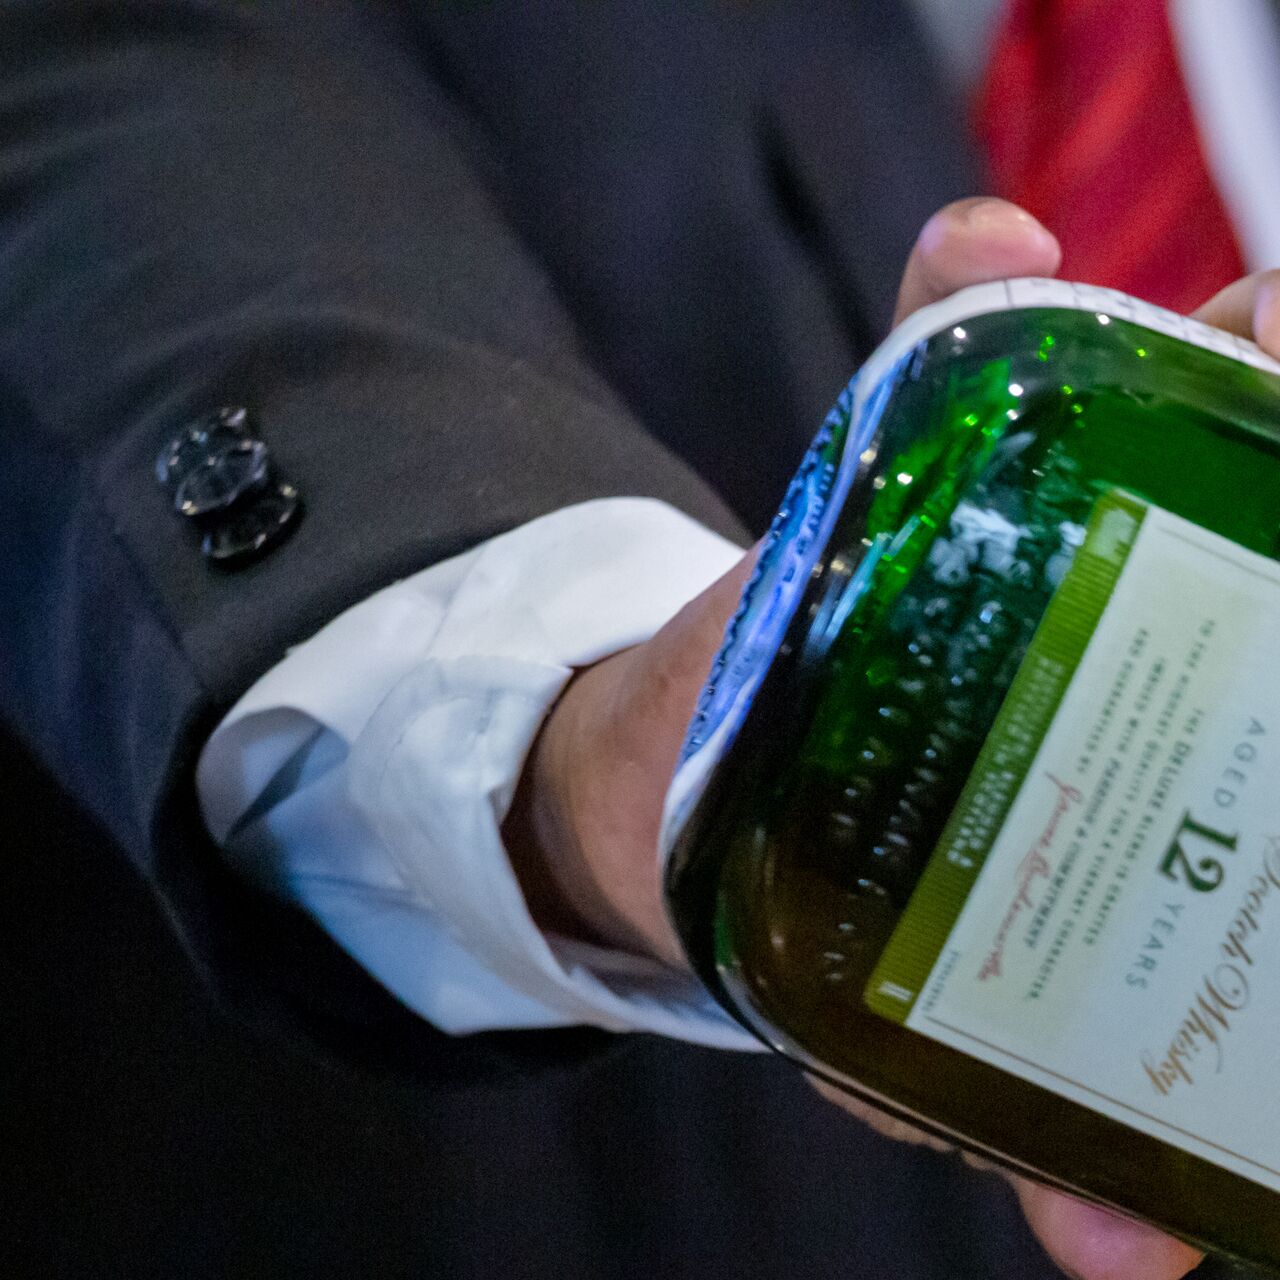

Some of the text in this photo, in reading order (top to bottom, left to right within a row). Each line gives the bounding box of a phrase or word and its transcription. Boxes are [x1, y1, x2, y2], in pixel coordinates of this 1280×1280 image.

[1123, 718, 1268, 990] AGED 12 YEARS
[1137, 957, 1255, 1104] Whisky
